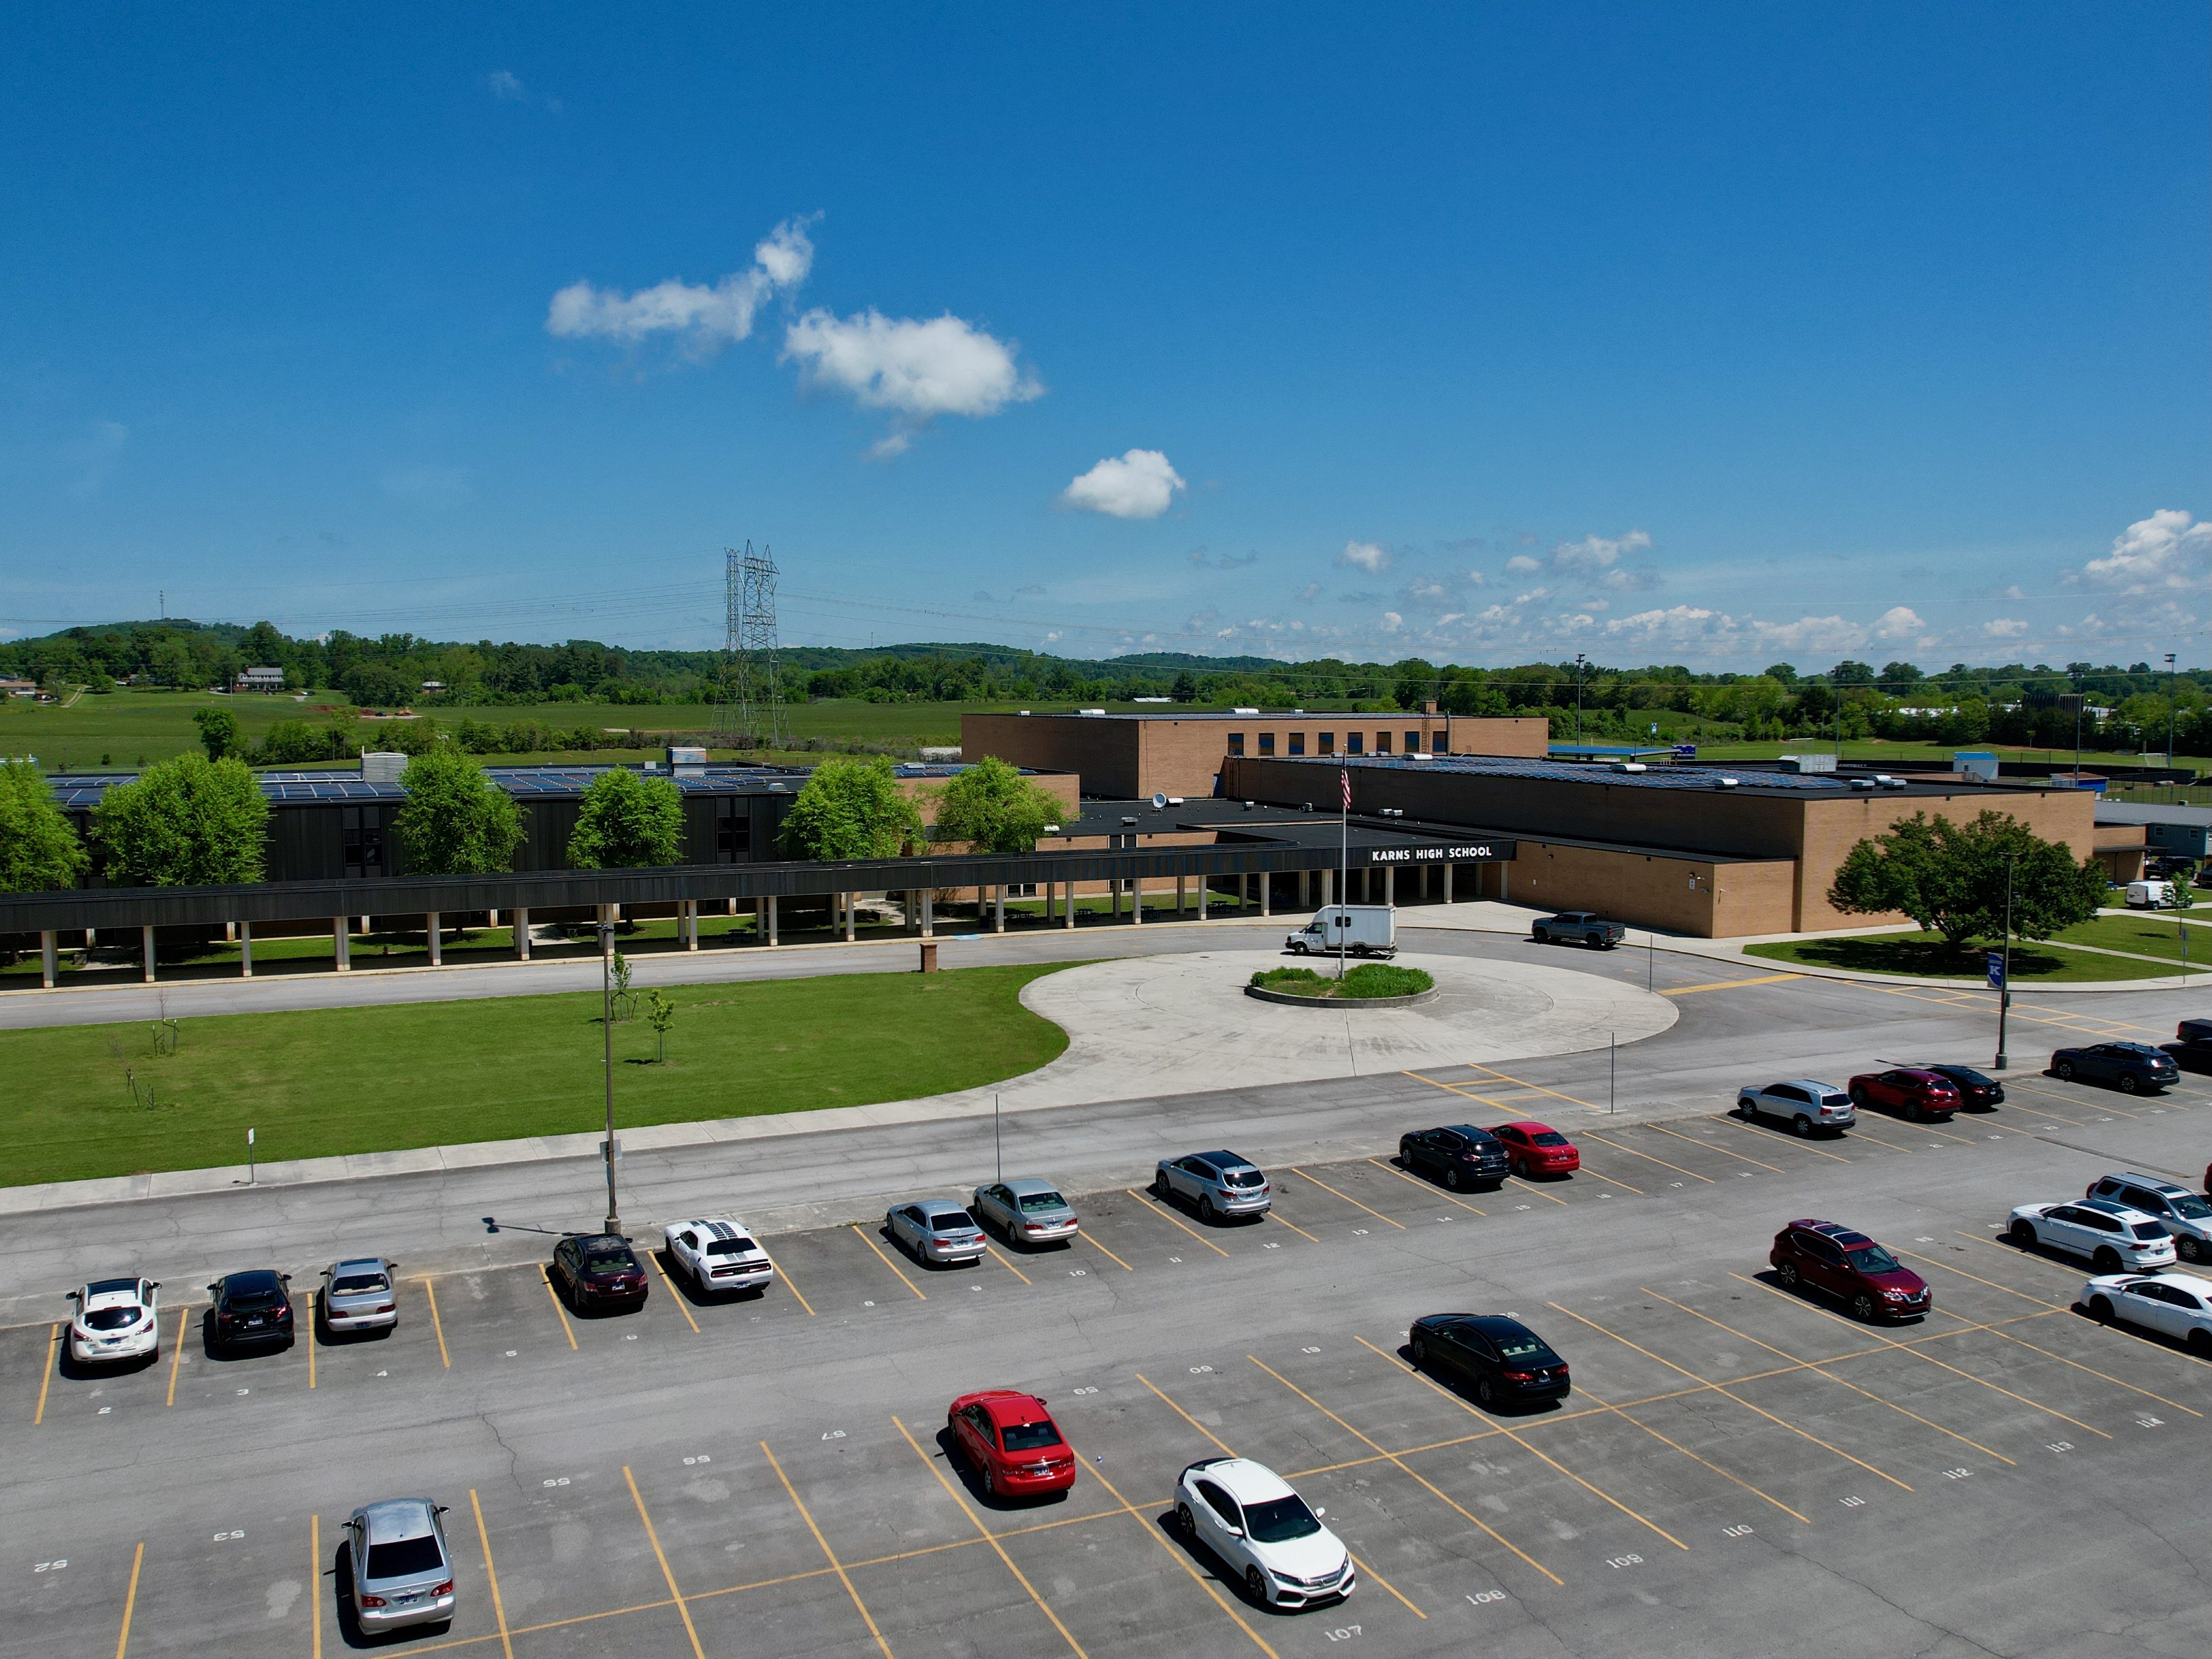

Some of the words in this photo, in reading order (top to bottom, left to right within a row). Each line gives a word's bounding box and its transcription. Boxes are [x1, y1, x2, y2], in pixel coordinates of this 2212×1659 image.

[1372, 850, 1410, 861] KARNS
[1416, 849, 1443, 859] HIGH
[1448, 846, 1492, 858] SCHOOL
[1989, 965, 2000, 975] K
[2135, 1418, 2165, 1428] 114
[821, 1430, 846, 1441] 57
[683, 1455, 711, 1465] 56
[1942, 1468, 1974, 1479] 112
[543, 1477, 570, 1487] 55
[1839, 1496, 1866, 1507] 111
[213, 1529, 245, 1541] 53
[1722, 1525, 1754, 1537] 110
[34, 1559, 68, 1572] 52
[1606, 1554, 1643, 1568] 109
[1465, 1590, 1506, 1605] 108
[1324, 1625, 1362, 1641] 107
